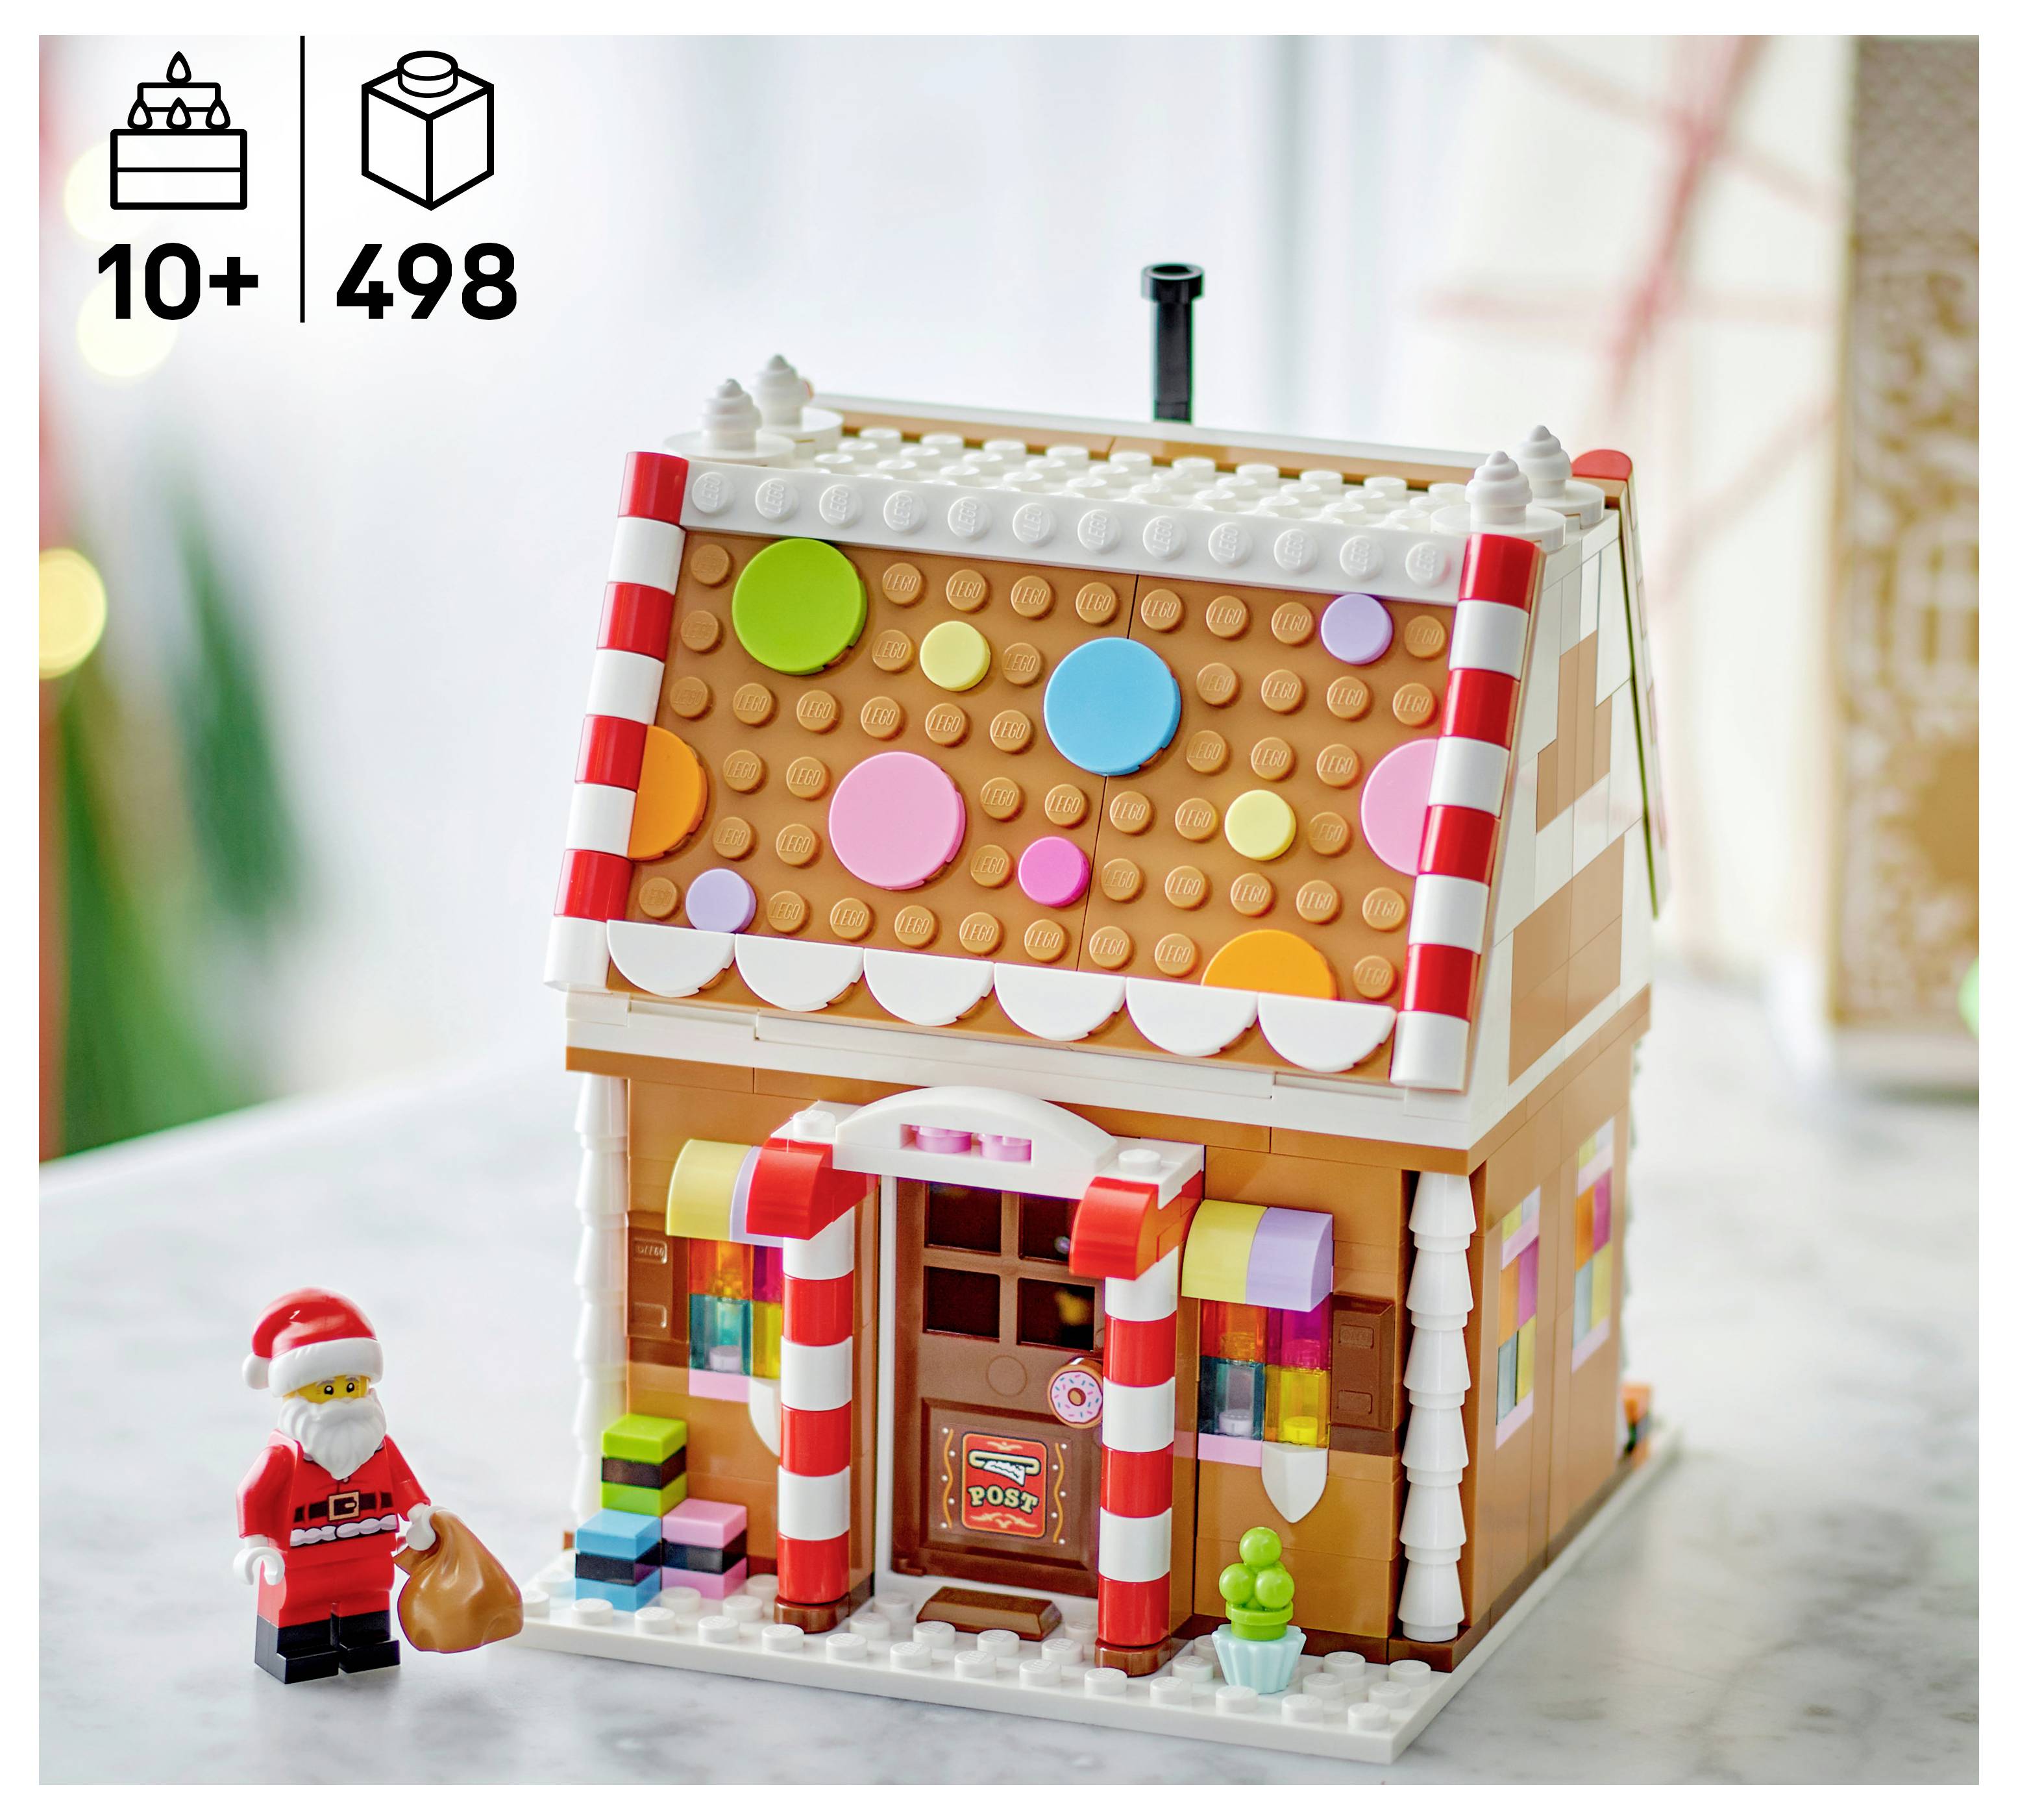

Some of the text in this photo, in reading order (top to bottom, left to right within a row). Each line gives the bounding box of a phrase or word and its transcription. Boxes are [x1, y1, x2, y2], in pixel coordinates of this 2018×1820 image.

[701, 474, 722, 509] LEGO
[765, 481, 785, 515] LEGO
[829, 487, 849, 521] LEGO
[959, 499, 977, 534] LEGO
[1089, 513, 1107, 545] LEGO
[1153, 519, 1173, 553] LEGO
[1218, 526, 1237, 558] LEGO
[886, 574, 917, 593] LEGO
[950, 580, 982, 599] LEGO
[1014, 587, 1046, 606] LEGO
[1079, 594, 1111, 613] LEGO
[1146, 600, 1177, 619] LEGO
[1211, 607, 1242, 625] LEGO
[1275, 613, 1308, 632] LEGO
[1410, 626, 1441, 645] LEGO
[876, 641, 906, 660] LEGO
[1004, 653, 1035, 672] LEGO
[1201, 673, 1233, 692] LEGO
[1266, 680, 1298, 700] LEGO
[738, 694, 768, 712] LEGO
[1331, 687, 1363, 707] LEGO
[1398, 693, 1429, 712] LEGO
[801, 701, 832, 720] LEGO
[865, 708, 897, 726] LEGO
[929, 714, 961, 733] LEGO
[994, 721, 1026, 740] LEGO
[1188, 743, 1221, 761] LEGO
[1256, 749, 1288, 767] LEGO
[727, 761, 758, 779] LEGO
[1322, 756, 1352, 774] LEGO
[791, 768, 821, 786] LEGO
[985, 789, 1015, 808] LEGO
[1050, 796, 1081, 815] LEGO
[1114, 803, 1146, 821] LEGO
[1179, 810, 1211, 828] LEGO
[716, 828, 746, 847] LEGO
[1314, 824, 1343, 842] LEGO
[780, 835, 811, 854] LEGO
[975, 857, 1005, 875] LEGO
[1105, 870, 1135, 888] LEGO
[1170, 878, 1201, 896] LEGO
[1235, 883, 1266, 902] LEGO
[1300, 891, 1333, 910] LEGO
[769, 903, 800, 921] LEGO
[1368, 898, 1399, 918] LEGO
[835, 910, 865, 929] LEGO
[899, 917, 930, 935] LEGO
[963, 924, 994, 943] LEGO
[1029, 931, 1061, 948] LEGO
[1094, 938, 1125, 956] LEGO
[1159, 944, 1191, 963] LEGO
[968, 1485, 1040, 1514] POST
